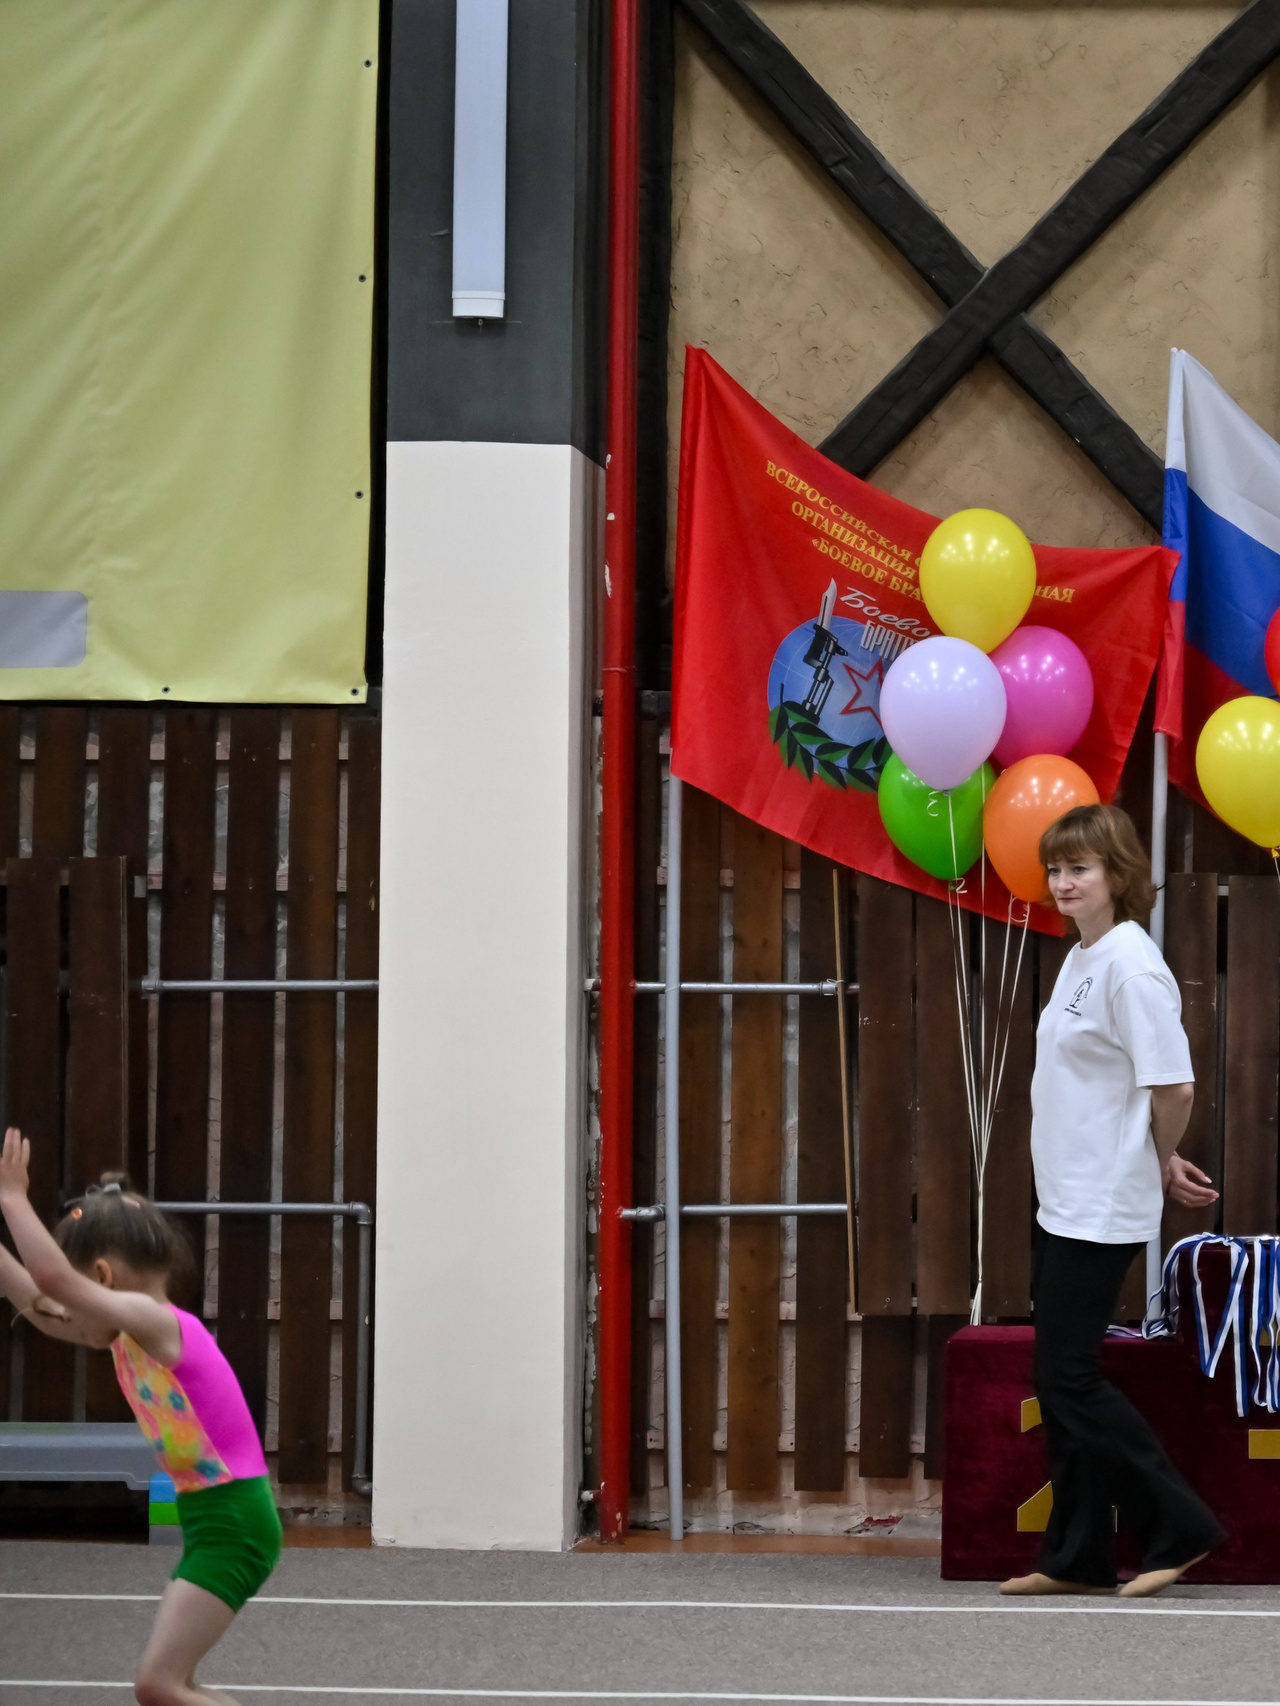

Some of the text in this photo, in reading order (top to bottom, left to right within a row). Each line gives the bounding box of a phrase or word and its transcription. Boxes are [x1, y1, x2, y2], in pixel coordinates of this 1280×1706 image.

[765, 460, 1076, 604] ВСЕРОССИЙСКАЯ НАЯ
[791, 501, 917, 580] ОРГАНИЗАЦИЯ
[811, 537, 888, 584] «БОЕВОЕ
[840, 586, 946, 638] Боево
